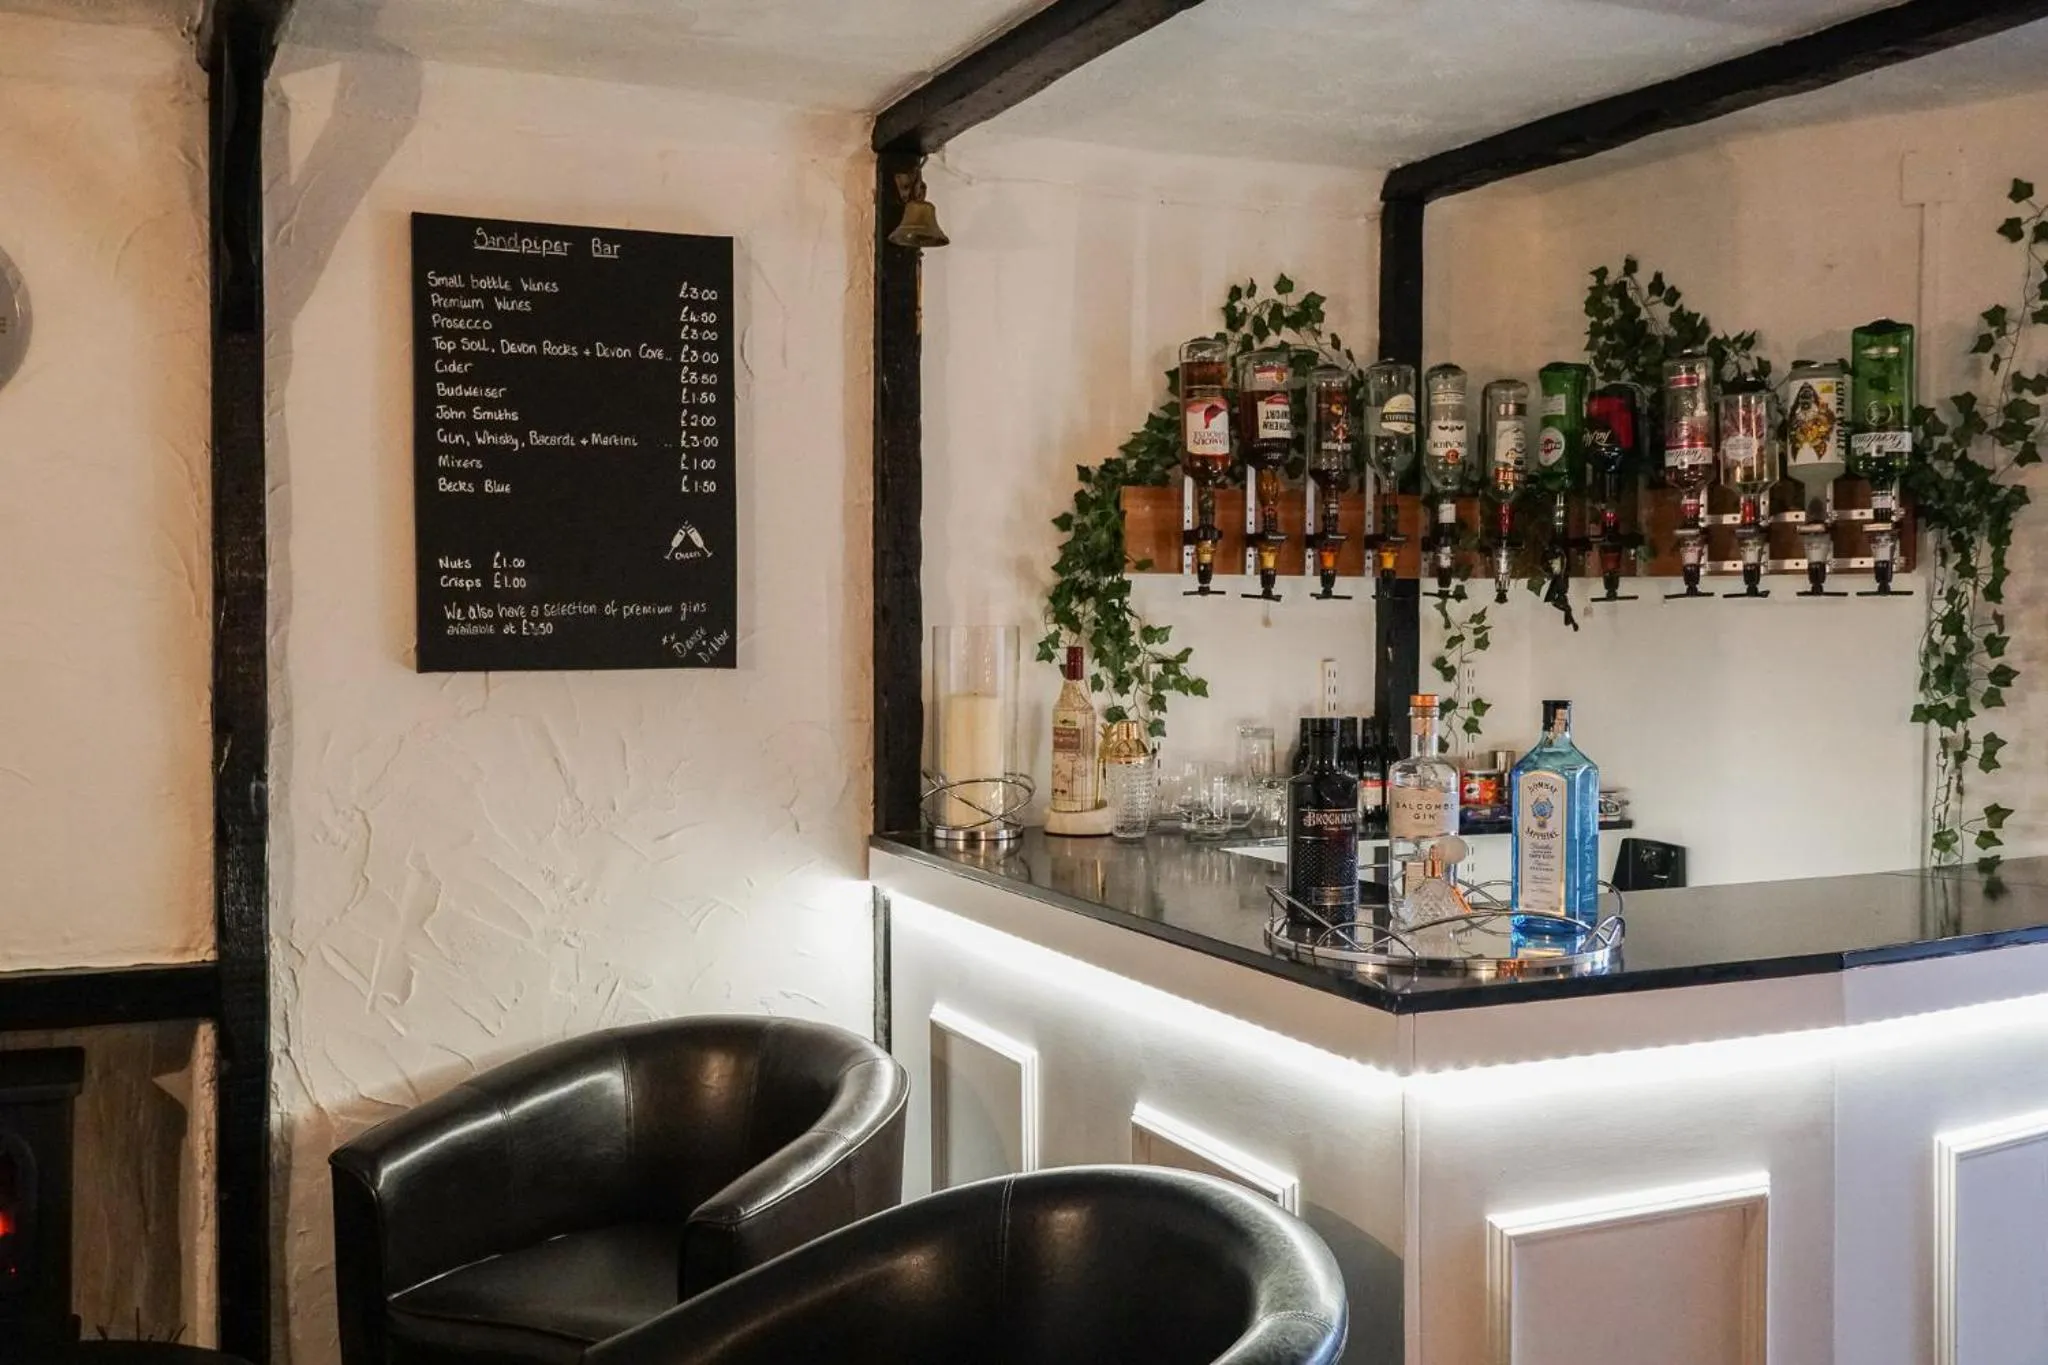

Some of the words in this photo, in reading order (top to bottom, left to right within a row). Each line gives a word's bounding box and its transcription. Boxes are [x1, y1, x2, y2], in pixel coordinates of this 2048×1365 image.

[473, 227, 573, 257] Sandpiper
[591, 238, 621, 258] Bar
[427, 271, 465, 289] Small
[471, 274, 512, 291] bottle
[520, 277, 560, 293] Wines
[431, 294, 484, 311] Premium
[494, 296, 532, 312] Wines
[431, 313, 493, 331] Prosecco
[432, 336, 456, 353] Top
[500, 339, 537, 355] Devon
[542, 340, 578, 357] Rocks
[595, 342, 632, 359] Devon
[435, 360, 473, 374] Cider
[436, 382, 507, 399] Budweiser
[436, 404, 466, 421] John
[473, 405, 519, 421] Smiths
[436, 428, 470, 447] Gin,
[529, 430, 575, 447] Bacardi
[590, 432, 639, 447] Martini
[437, 454, 483, 470] Mixers
[437, 478, 475, 494] Becks
[484, 478, 511, 494] Blue
[438, 556, 472, 570] Nuts
[492, 551, 526, 569] £1.00
[440, 574, 482, 592] Crisps
[493, 571, 527, 589] £1.00
[444, 602, 466, 621] We
[468, 602, 494, 619] also
[498, 602, 526, 619] have
[530, 607, 539, 619] a
[604, 600, 618, 616] of
[622, 603, 673, 619] premium
[680, 601, 707, 621] gins
[447, 623, 496, 636] available
[503, 621, 517, 635] at
[1413, 813, 1436, 821] GIN
